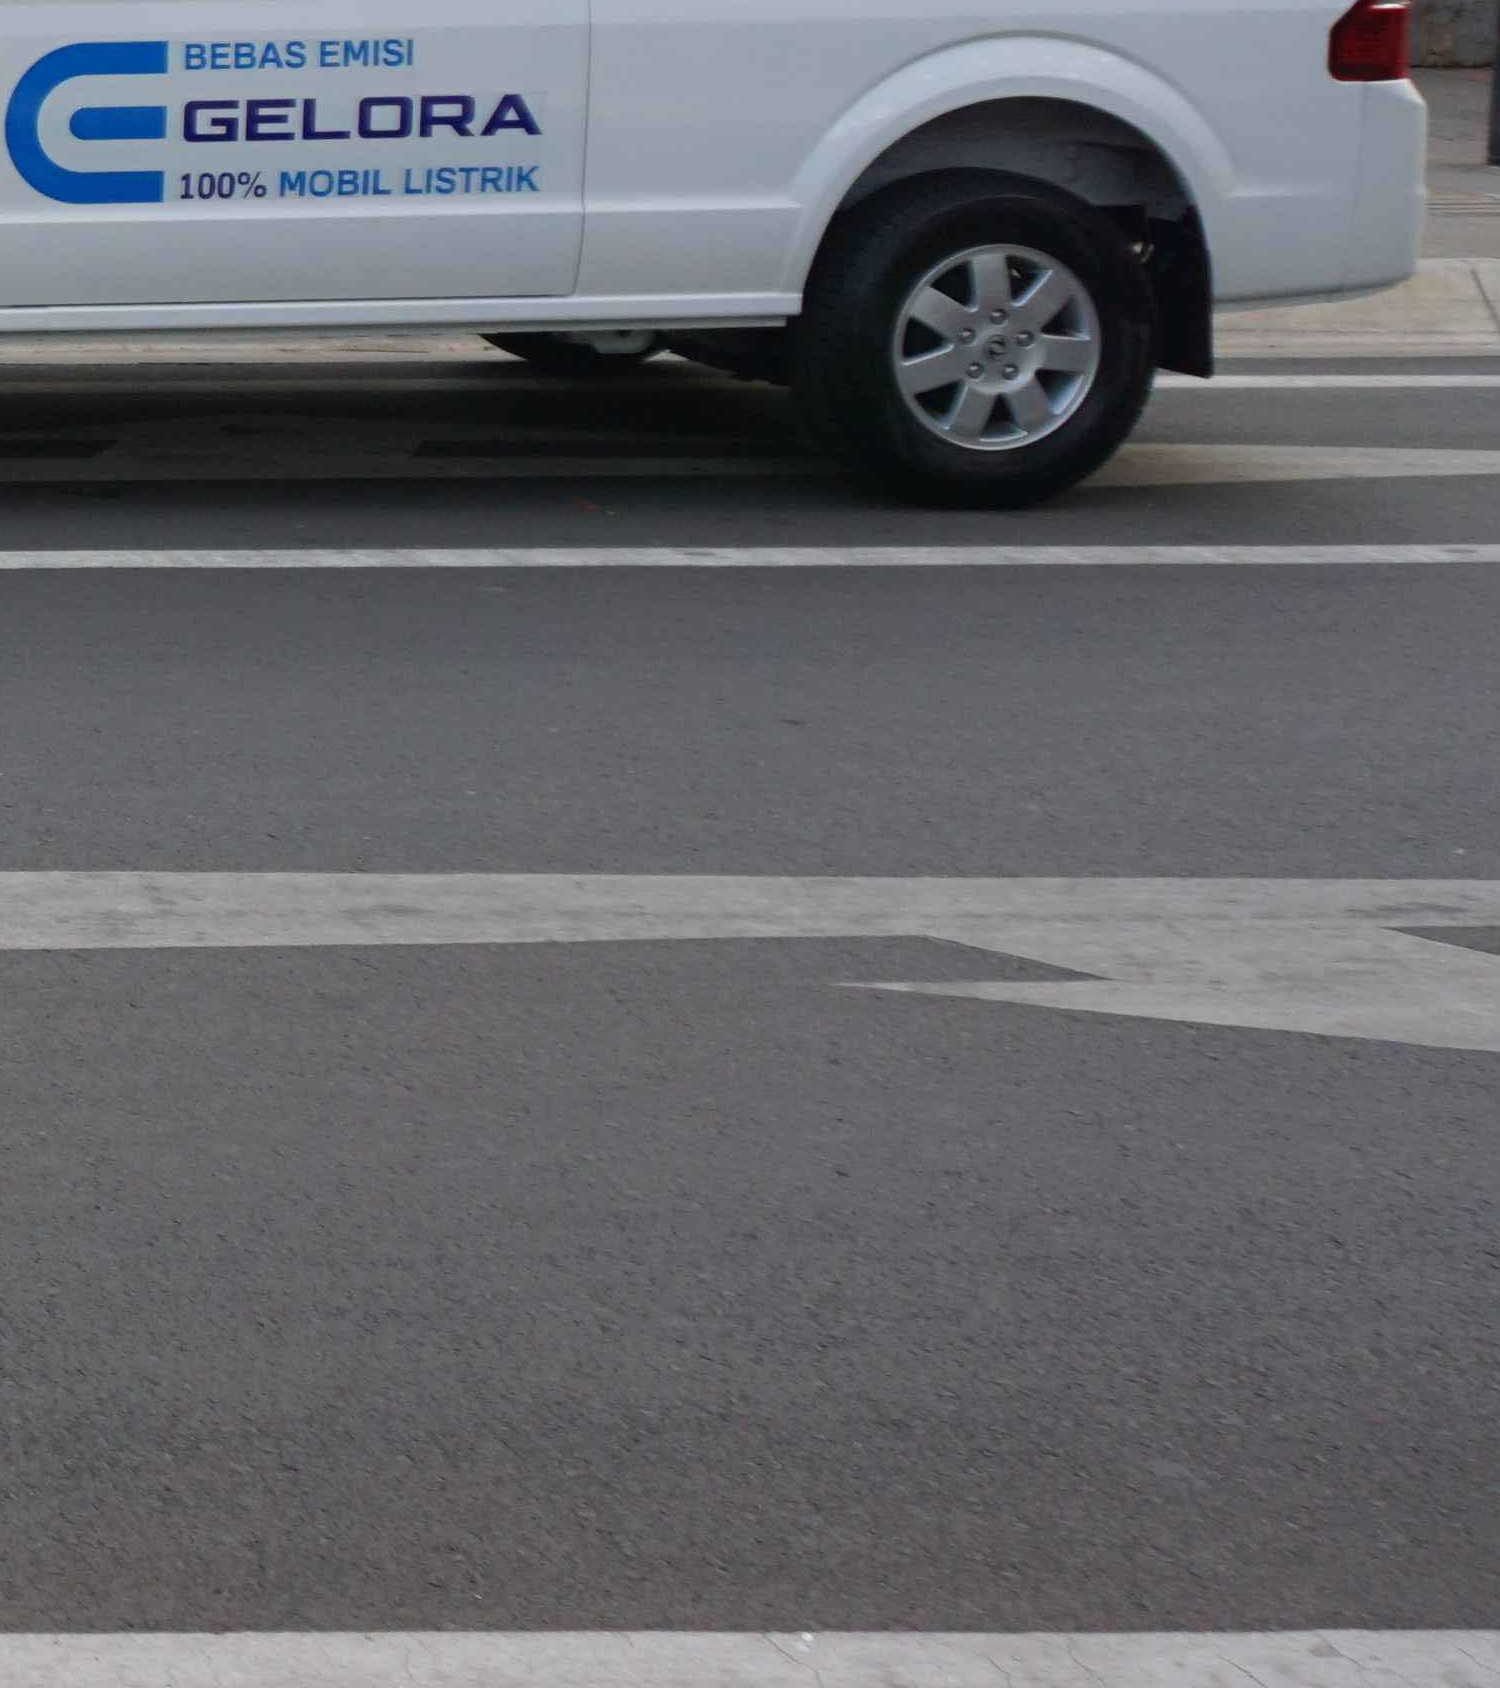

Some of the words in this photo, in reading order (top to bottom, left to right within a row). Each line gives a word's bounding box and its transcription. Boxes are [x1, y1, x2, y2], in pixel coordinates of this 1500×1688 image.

[184, 40, 307, 70] BEBAS
[319, 38, 415, 67] EMISI
[182, 93, 544, 144] GELORA
[180, 170, 267, 200] 100%
[278, 168, 392, 198] MOBIL
[404, 166, 541, 196] LISTRIK
